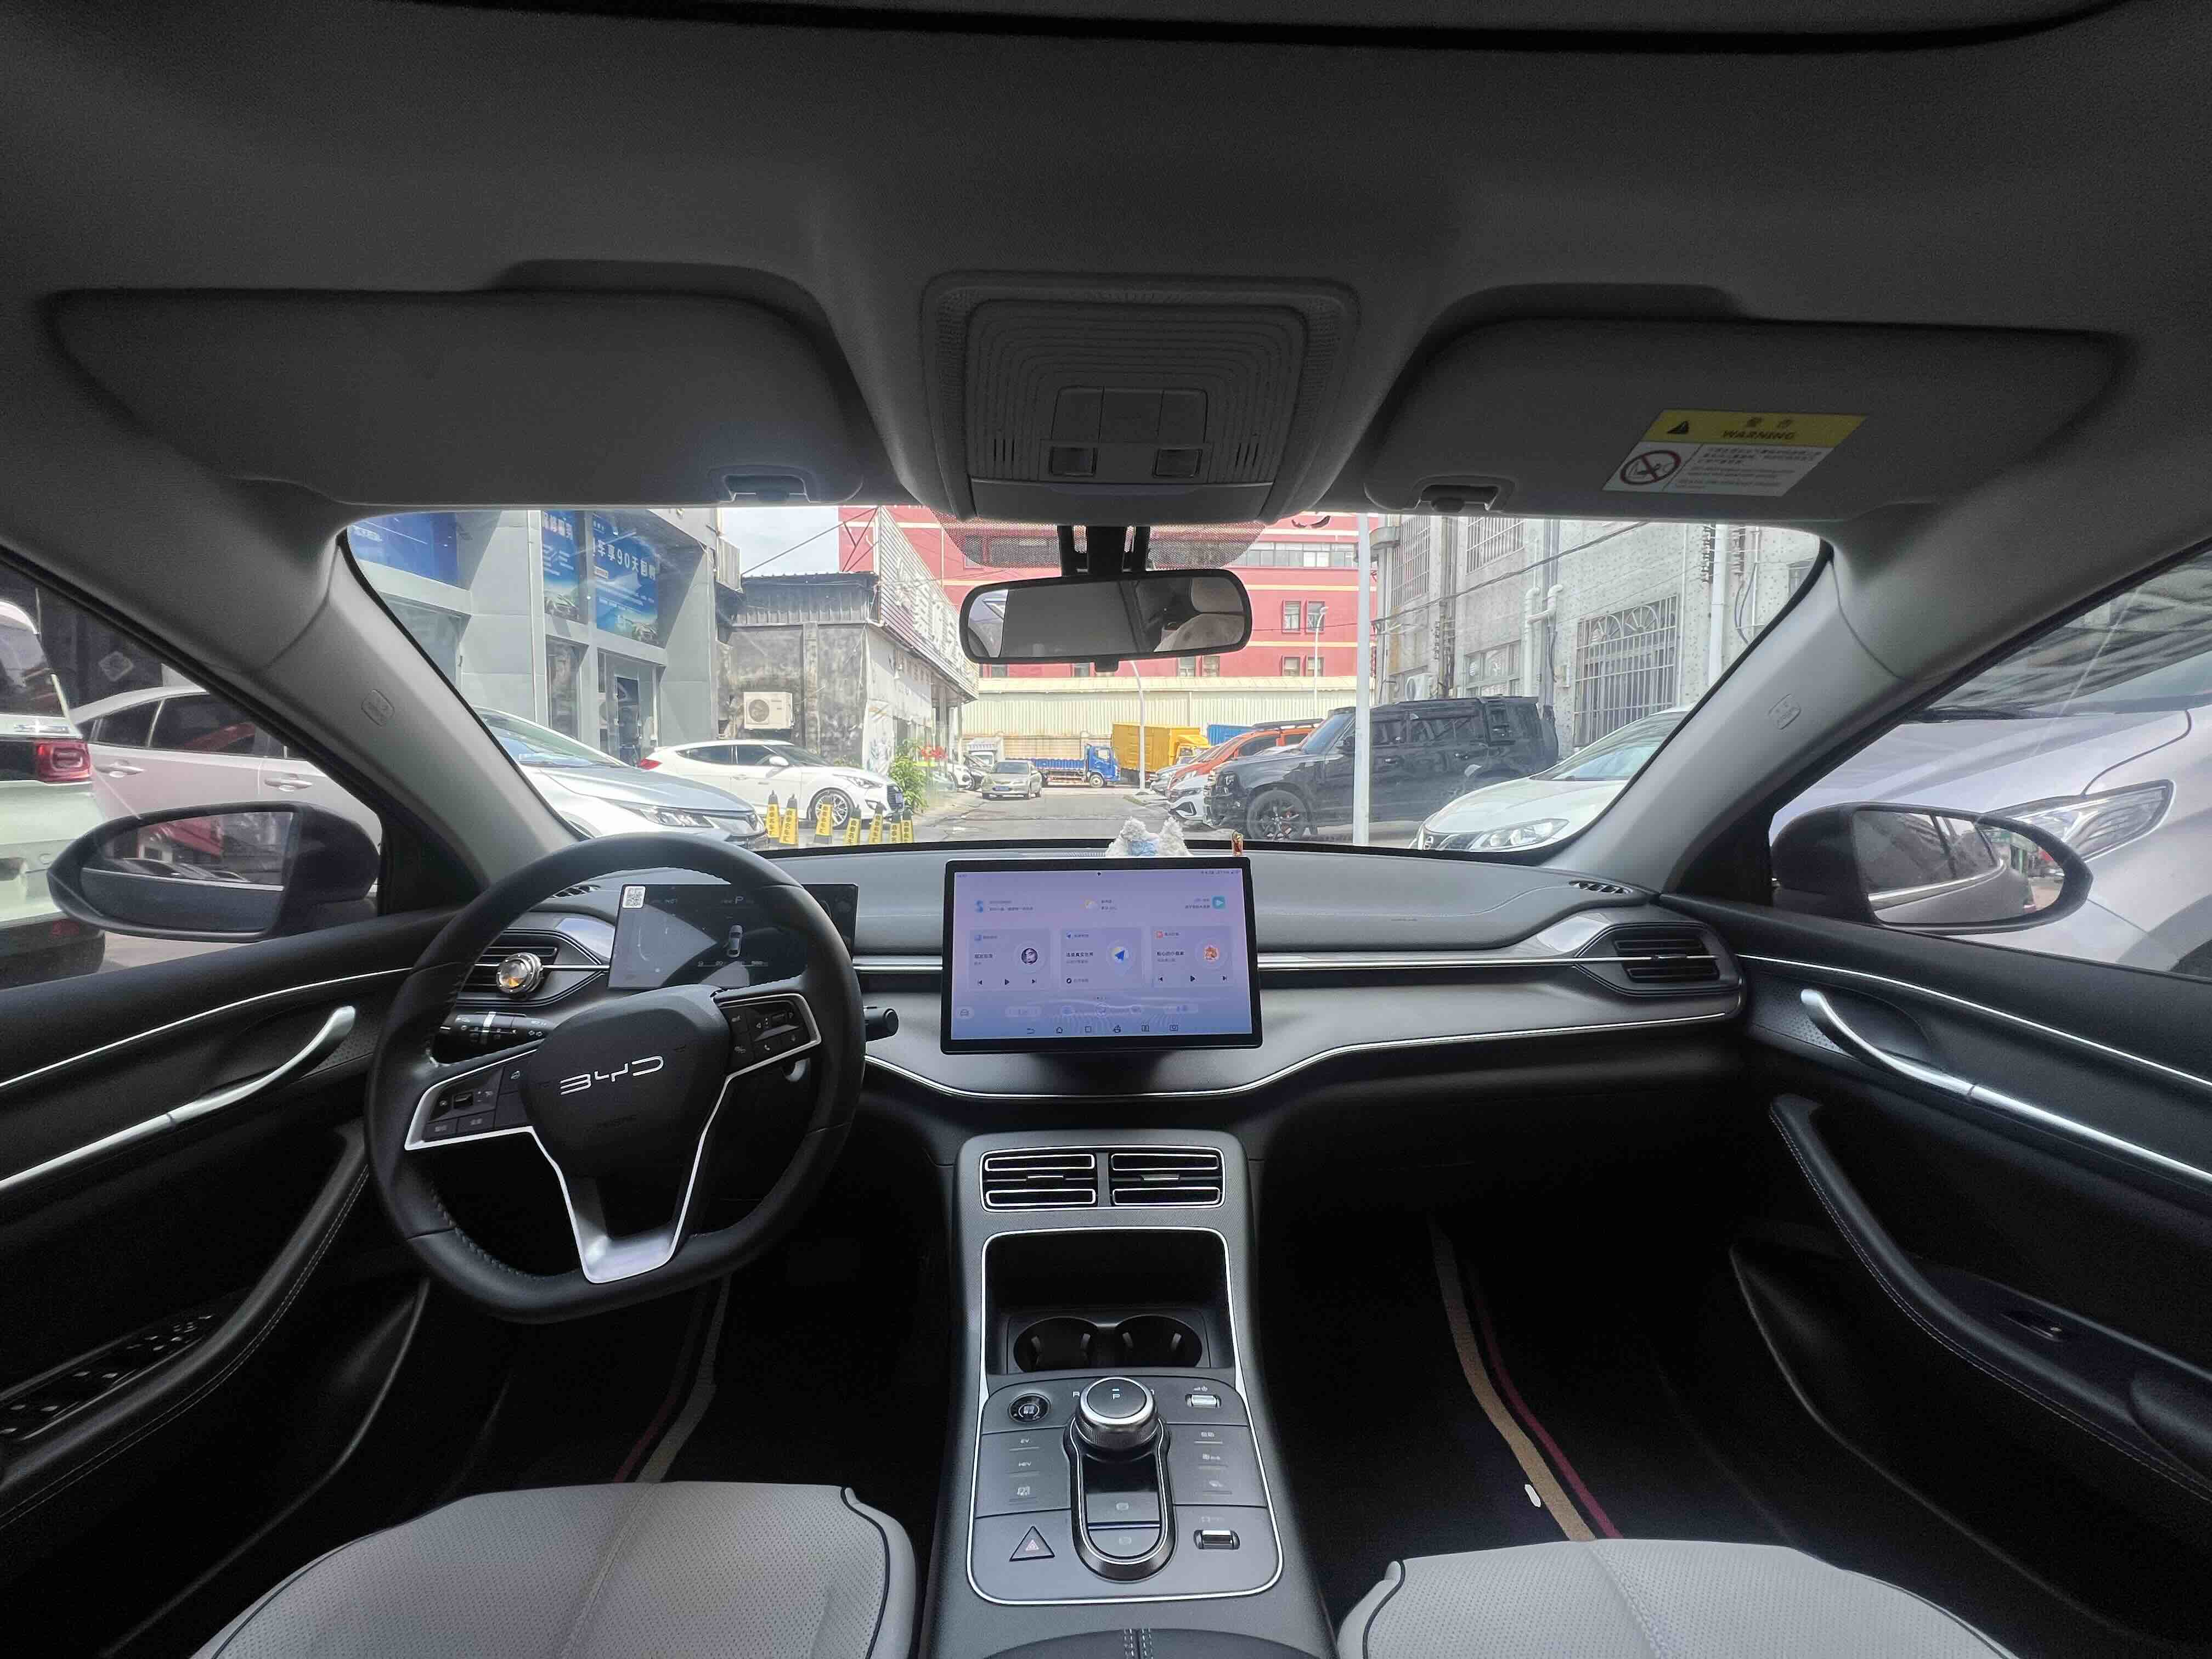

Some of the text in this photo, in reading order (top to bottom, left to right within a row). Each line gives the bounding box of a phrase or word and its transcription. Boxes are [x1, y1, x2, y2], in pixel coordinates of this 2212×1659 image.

[1722, 430, 1795, 439] WARNING
[735, 896, 743, 904] P
[560, 1056, 664, 1096] BYD
